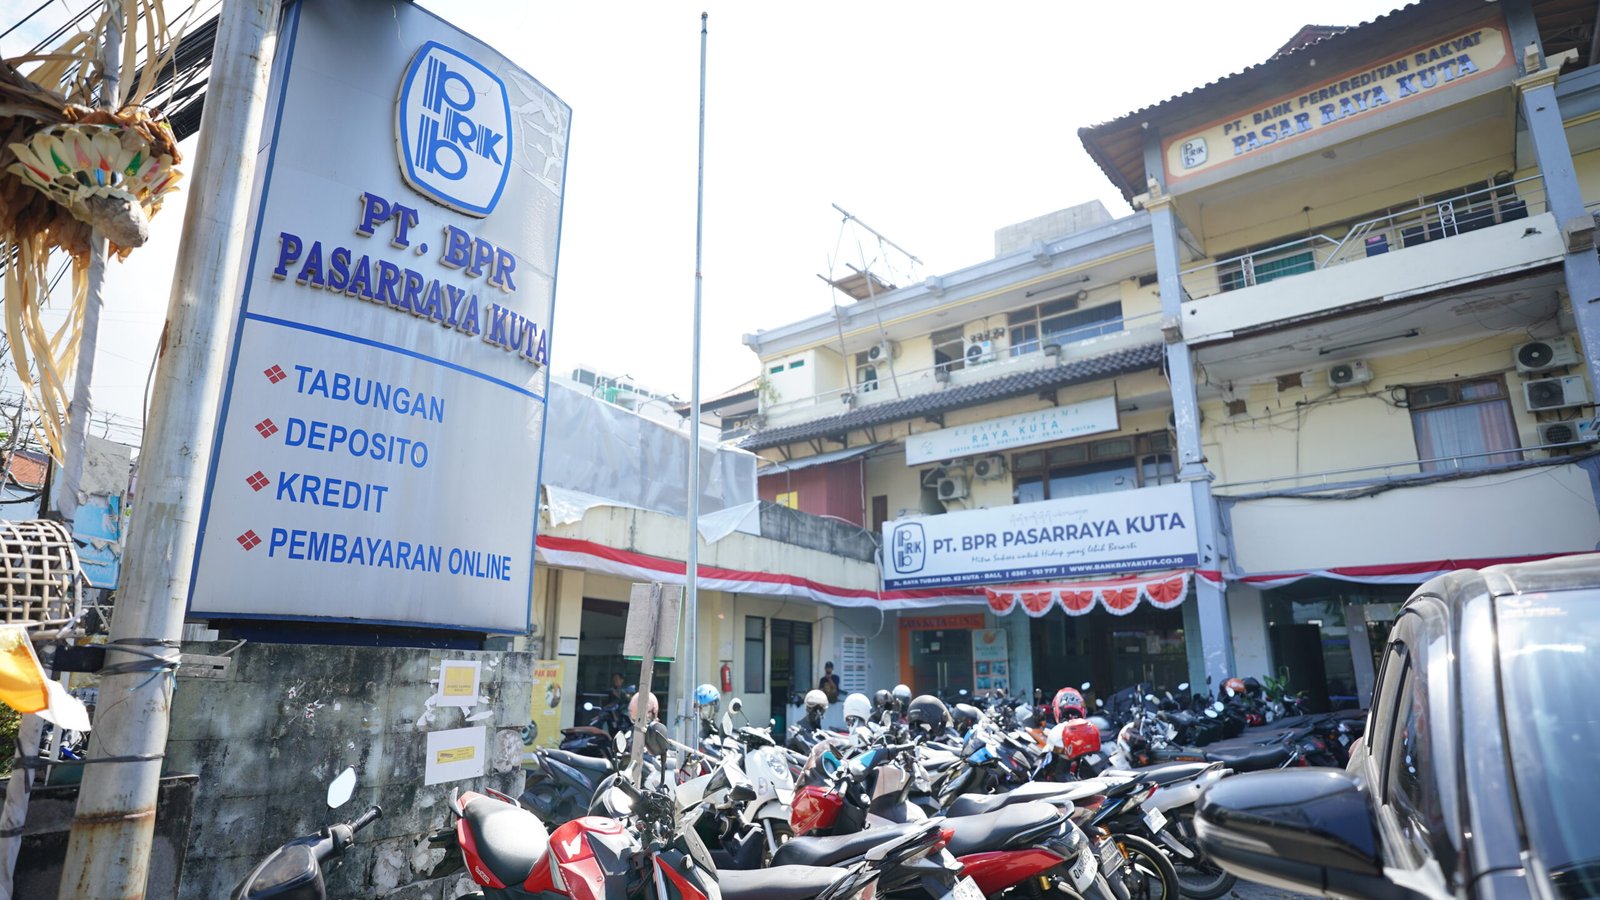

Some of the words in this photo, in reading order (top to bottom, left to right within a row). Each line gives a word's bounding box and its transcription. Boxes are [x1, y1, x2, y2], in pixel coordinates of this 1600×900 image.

[1223, 120, 1247, 136] PT.
[1254, 102, 1293, 125] BANK
[1299, 59, 1408, 109] PERKREDITAN
[1416, 31, 1482, 66] RAKYAT
[1231, 112, 1312, 156] PASAR
[1320, 85, 1391, 126] RAYA
[1396, 54, 1479, 99] KUTA
[356, 191, 428, 256] PT.
[440, 224, 517, 292] BPR
[271, 232, 481, 336] PASARRAYA
[485, 302, 548, 367] KUTA
[294, 364, 445, 424] TABUNGAN
[284, 417, 429, 469] DEPOSITO
[971, 429, 1009, 443] RAYA
[1018, 420, 1059, 435] KUTA
[276, 471, 389, 513] KREDIT
[268, 527, 442, 573] PEMBAYARAN
[448, 548, 511, 582] ONLINE
[933, 537, 957, 554] PT.
[962, 532, 997, 552] BPR
[1002, 518, 1119, 547] PASARRAYA
[1125, 511, 1186, 534] KUTA
[1066, 548, 1085, 558] yang
[920, 577, 941, 585] TUBAN
[962, 574, 980, 582] KUTA
[1011, 570, 1027, 578] 0361
[1069, 557, 1184, 573] WWW.BANKRAYAKUTA.CO.ID
